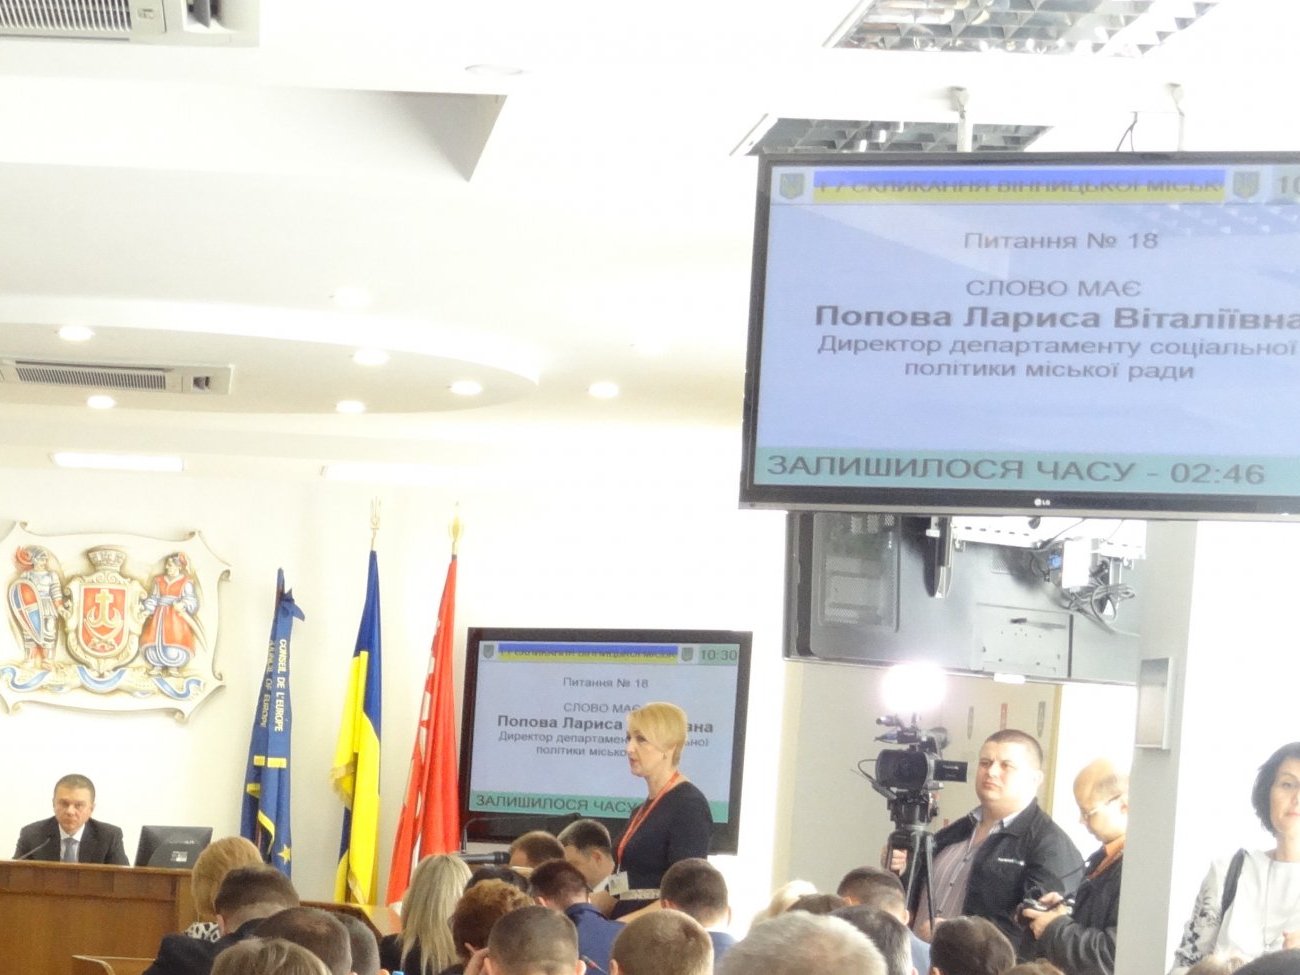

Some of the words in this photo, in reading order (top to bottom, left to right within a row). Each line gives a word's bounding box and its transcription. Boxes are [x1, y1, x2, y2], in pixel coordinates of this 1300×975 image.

[964, 232, 1077, 249] Питання
[1087, 232, 1117, 250] №
[1128, 232, 1158, 249] 18
[966, 279, 1068, 297] СЛОВО
[1077, 279, 1142, 297] МАЄ
[815, 305, 952, 327] Попова
[963, 306, 1101, 332] Лариса
[1114, 307, 1300, 330] Віталіївна
[817, 335, 942, 356] Директор
[949, 339, 1141, 357] департаменту
[1150, 339, 1298, 359] соціальної
[905, 361, 1016, 377] політики
[1025, 362, 1120, 378] міської
[1128, 365, 1194, 381] ради
[767, 455, 1024, 480] ЗАЛИШИЛОСЯ
[1037, 461, 1136, 482] ЧАСУ
[1170, 462, 1265, 485] 02:46
[277, 639, 287, 674] CONSEIL
[700, 649, 738, 661] 10:30
[276, 676, 286, 689] DE
[563, 677, 613, 688] Питання
[616, 678, 631, 688] №
[635, 679, 649, 688] 18
[563, 702, 609, 713] СЛОВО
[497, 715, 558, 728] Попова
[562, 717, 623, 732] Лариса
[498, 731, 553, 743] Директор
[556, 733, 628, 745] департамен
[536, 745, 586, 756] політики
[589, 746, 627, 758] місько
[476, 794, 589, 811] ЗАЛИШИЛОСЯ
